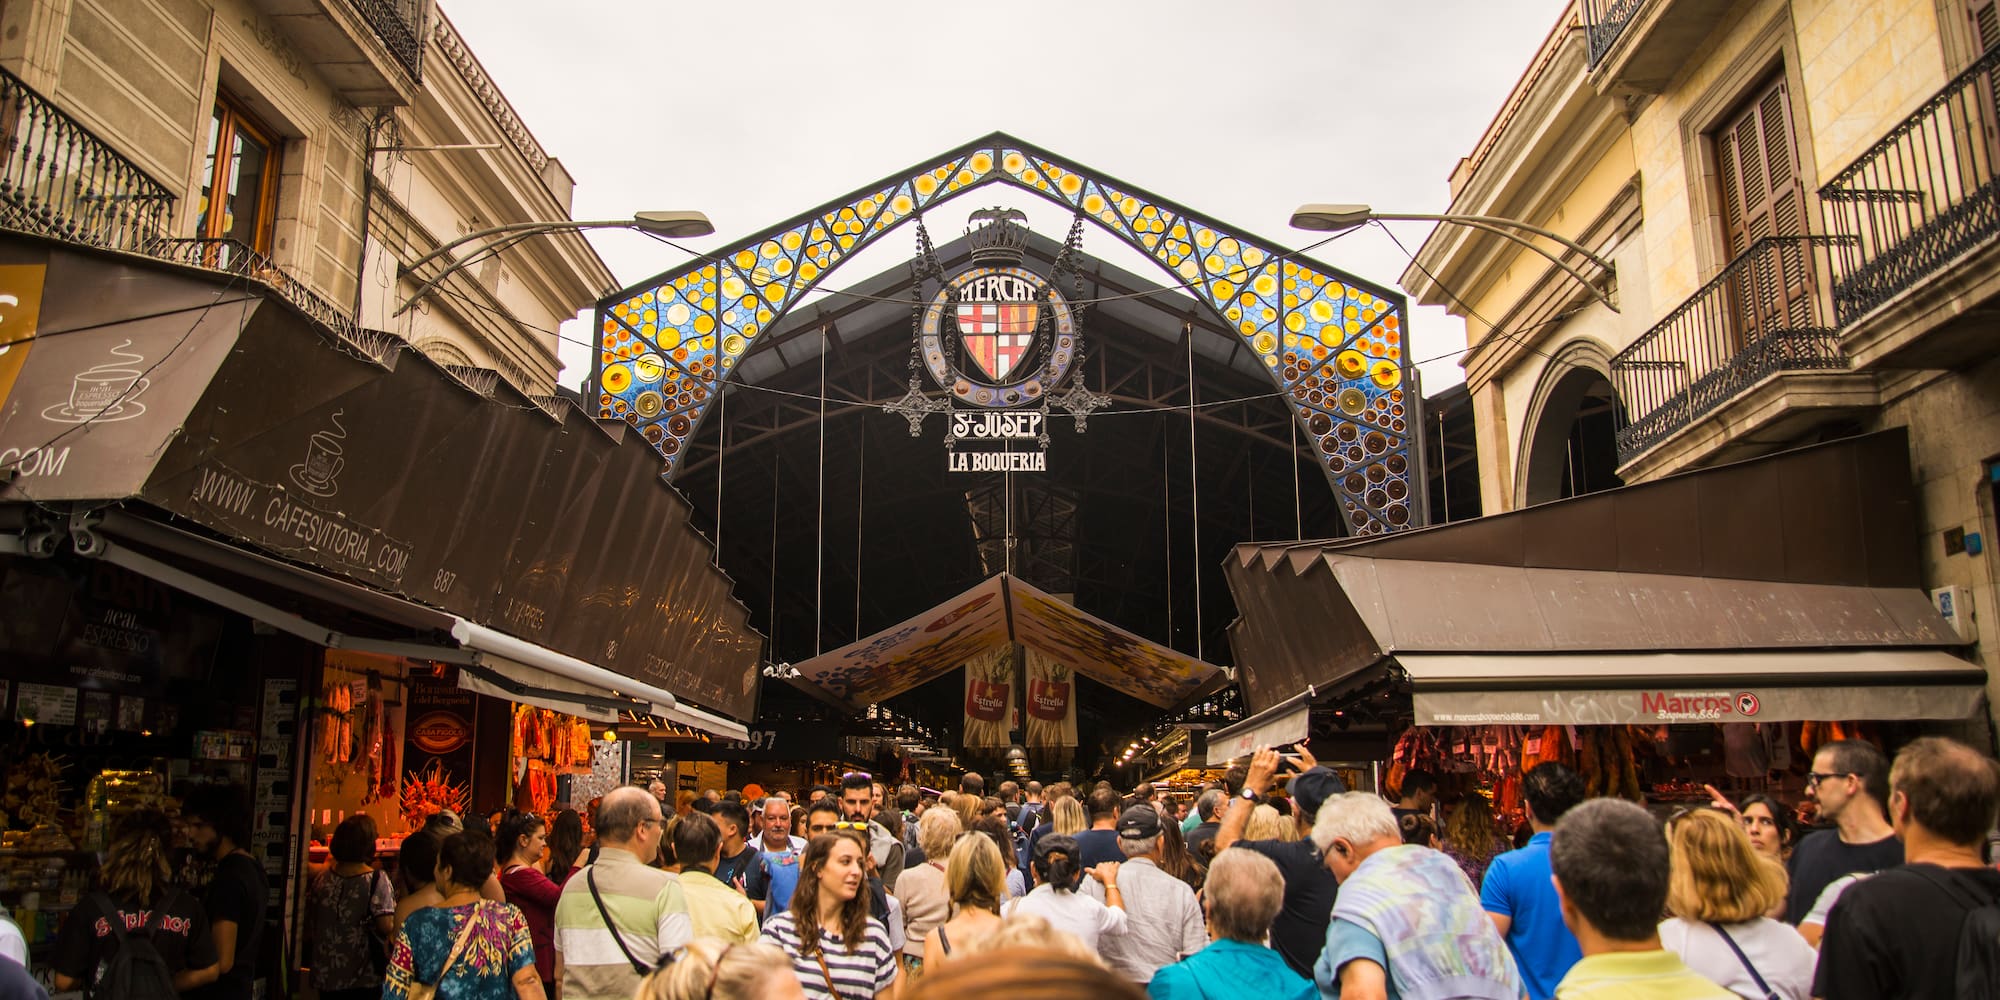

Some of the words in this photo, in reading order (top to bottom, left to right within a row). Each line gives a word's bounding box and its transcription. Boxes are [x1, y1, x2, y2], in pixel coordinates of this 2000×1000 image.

[959, 275, 1037, 302] MERCAT
[972, 411, 1043, 438] JOSEP
[949, 451, 969, 472] LA
[971, 451, 1047, 472] BOQUERIA
[433, 567, 457, 594] 887
[82, 623, 150, 653] ESPRESSO
[974, 694, 1003, 708] Estrella
[1033, 694, 1065, 707] Estrella
[1641, 691, 1733, 714] Marcos
